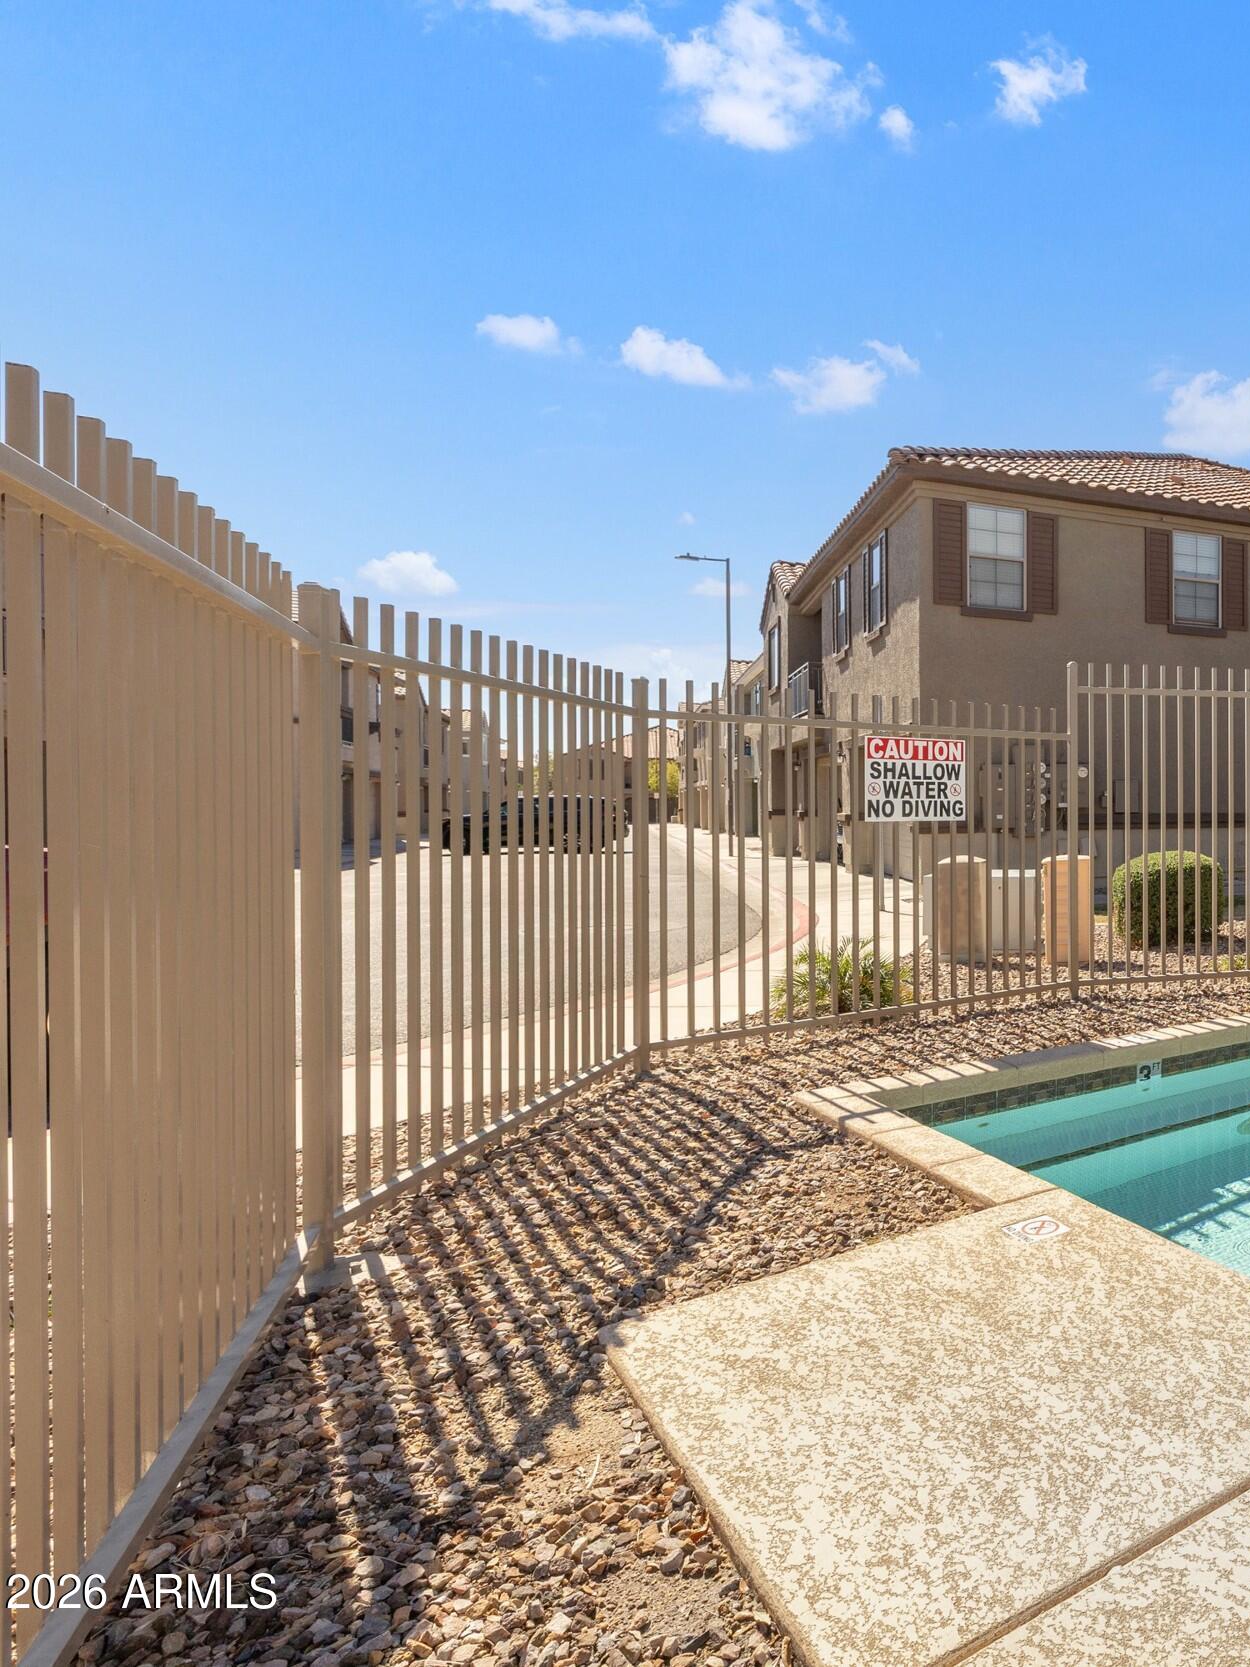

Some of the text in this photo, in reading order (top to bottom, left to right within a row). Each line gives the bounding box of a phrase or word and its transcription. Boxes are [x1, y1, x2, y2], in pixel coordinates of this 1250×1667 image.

[869, 738, 962, 761] CAUTION
[869, 761, 961, 780] SHALLOW
[883, 780, 949, 799] WATER
[867, 799, 964, 818] NO DIVING
[1139, 1062, 1160, 1081] 3 FT
